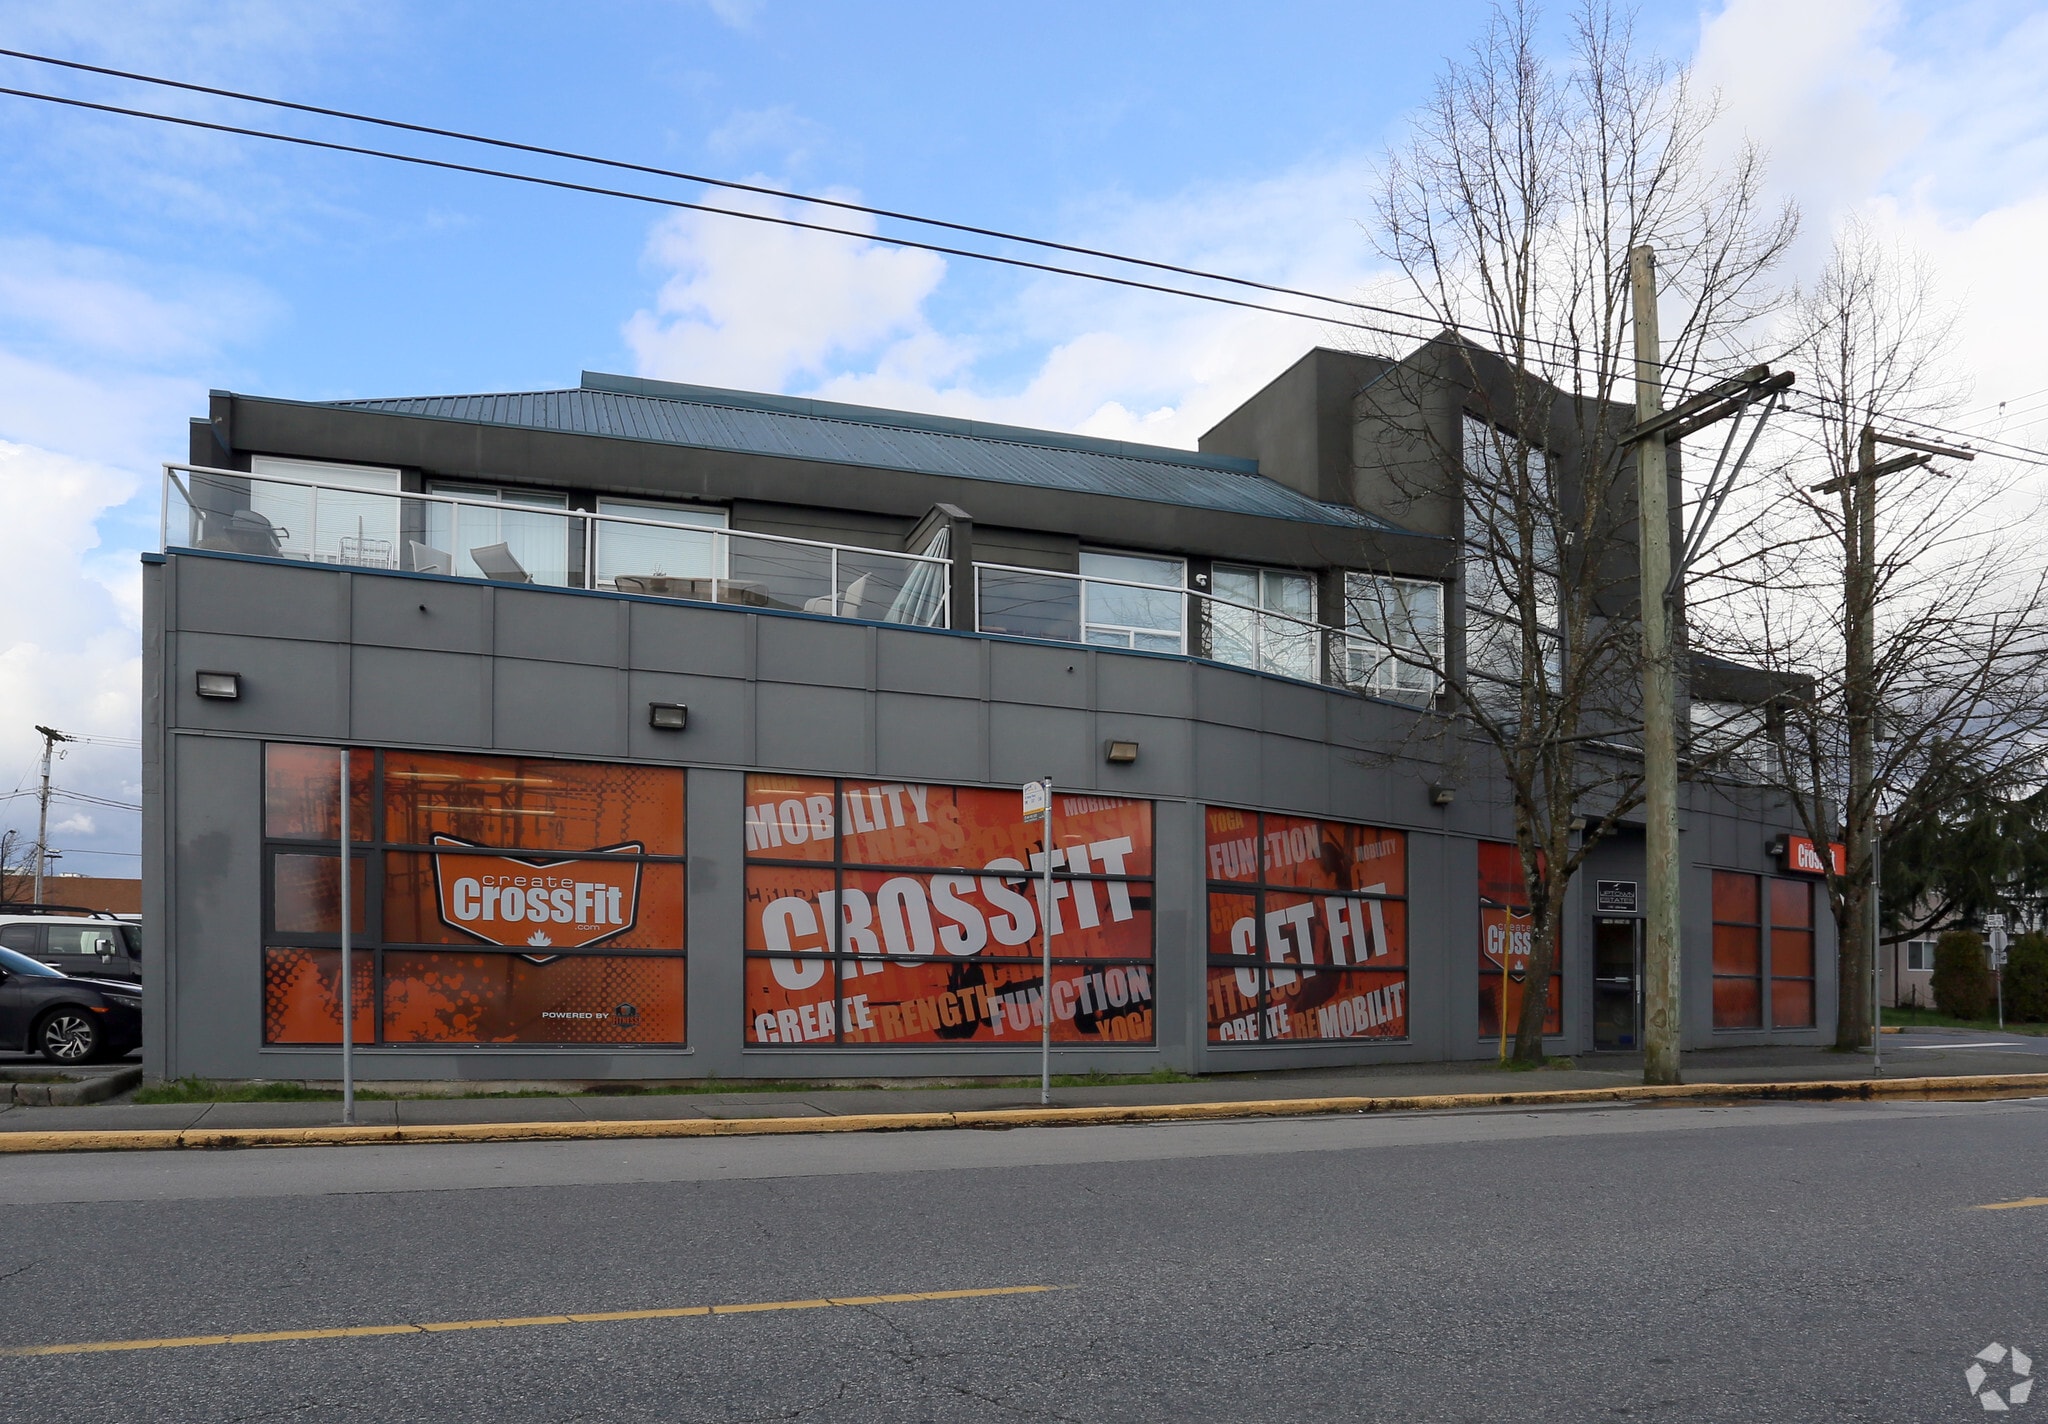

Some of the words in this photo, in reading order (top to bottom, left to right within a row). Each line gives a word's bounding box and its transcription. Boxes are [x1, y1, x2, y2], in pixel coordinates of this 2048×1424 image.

[746, 784, 929, 851] MOBILITY
[1209, 812, 1244, 834] YOGA
[1209, 825, 1321, 880] FUNCTION
[453, 877, 623, 925] CrossFit
[482, 875, 574, 888] create
[762, 836, 1134, 990] CROSSFIT
[1324, 882, 1388, 966] FIT
[755, 993, 874, 1044] CREATE
[988, 965, 1152, 1036] FUNCTION
[1318, 981, 1406, 1038] MOBILIT
